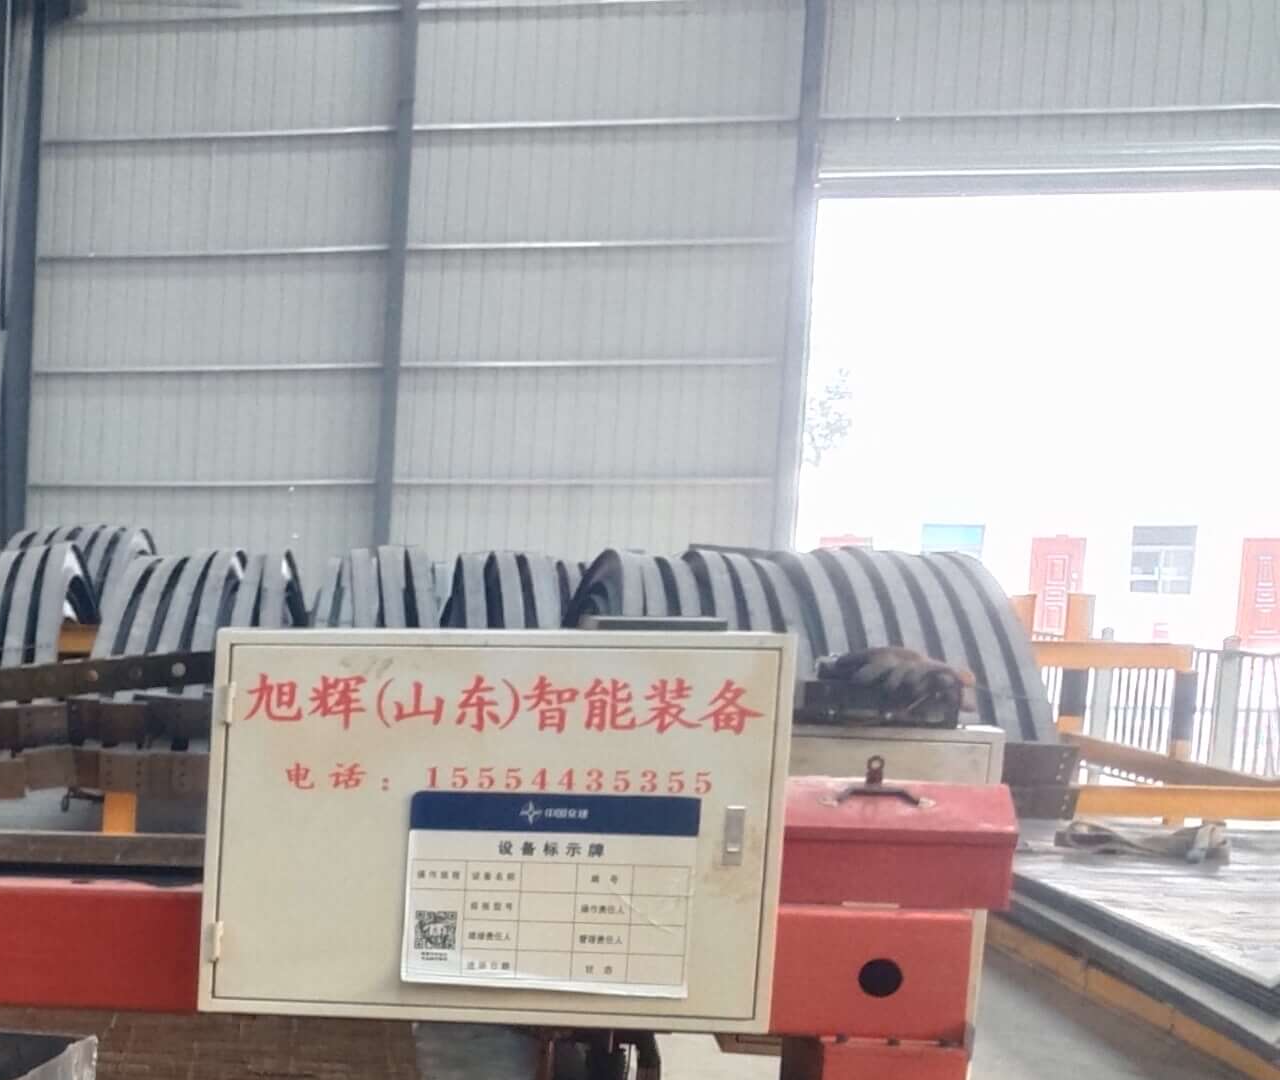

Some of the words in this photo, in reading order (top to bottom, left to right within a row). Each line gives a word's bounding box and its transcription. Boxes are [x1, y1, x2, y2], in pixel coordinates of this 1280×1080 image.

[243, 672, 765, 736] 旭辉(山东)智能装备
[426, 766, 713, 795] 15554435355
[498, 840, 605, 858] 设备标示牌
